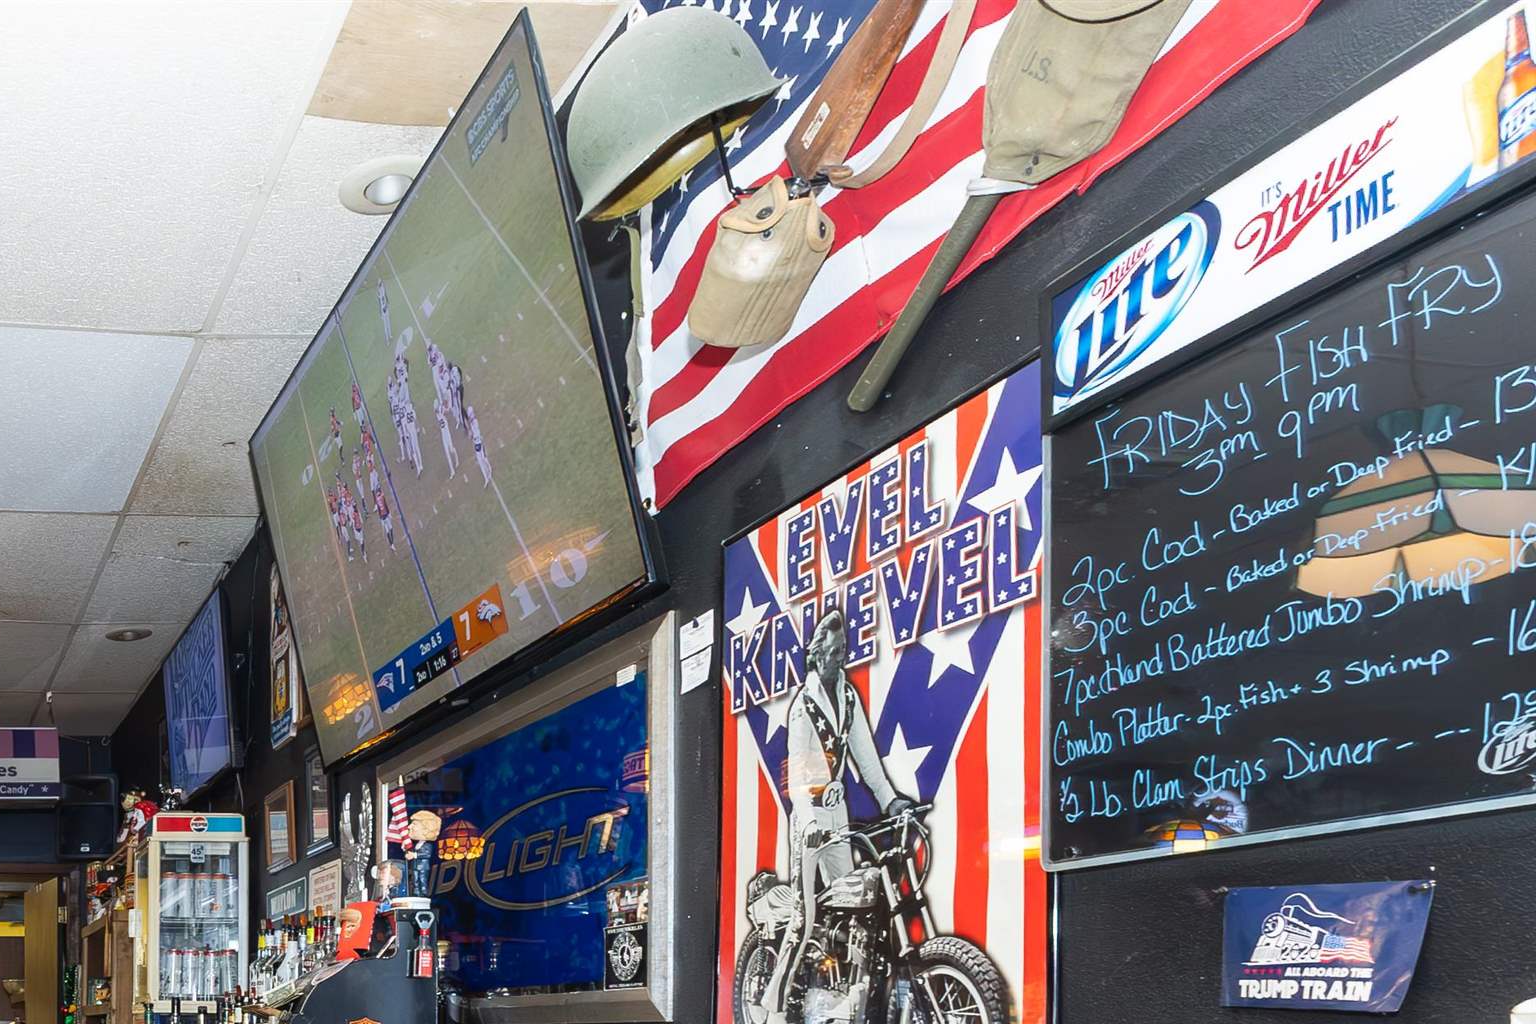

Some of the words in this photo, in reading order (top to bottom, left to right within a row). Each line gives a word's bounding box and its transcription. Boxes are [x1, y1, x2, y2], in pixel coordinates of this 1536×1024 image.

[1234, 115, 1399, 275] Miller
[1260, 181, 1284, 208] IT'S
[1327, 170, 1396, 243] TIME
[1070, 222, 1193, 392] Lite
[1091, 239, 1155, 301] Miller
[1088, 382, 1253, 487] FRIDAY
[1266, 320, 1368, 401] FISH
[1379, 254, 1502, 345] FRY
[785, 439, 946, 603] EVEL
[1143, 522, 1206, 570] Cod
[1230, 495, 1300, 533] Baked
[1307, 481, 1330, 498] or
[1328, 455, 1389, 487] Deep
[1392, 415, 1453, 459] Fried
[1141, 582, 1196, 627] Cod
[1225, 554, 1288, 592] Baked
[1293, 546, 1315, 565] or
[1314, 528, 1368, 555] Deep
[1371, 488, 1443, 531] Fried
[459, 611, 471, 641] 7
[1168, 615, 1270, 672] Battered
[1276, 597, 1363, 643] Jumbo
[1372, 553, 1485, 618] Shrimp
[395, 658, 406, 685] 7
[1054, 719, 1112, 766] Combo
[1239, 682, 1288, 709] Fish
[1313, 670, 1332, 694] 3
[1345, 648, 1450, 685] Shrimp
[1133, 769, 1185, 808] Clam
[1193, 755, 1267, 801] Strips
[1272, 736, 1389, 780] Dinner
[481, 806, 627, 885] LIGHT
[1238, 979, 1299, 1000] TRUMP
[1300, 980, 1373, 1002] TRAIN
[1284, 967, 1301, 978] ALL
[1302, 967, 1348, 978] ABOARD
[1349, 966, 1374, 978] THE
